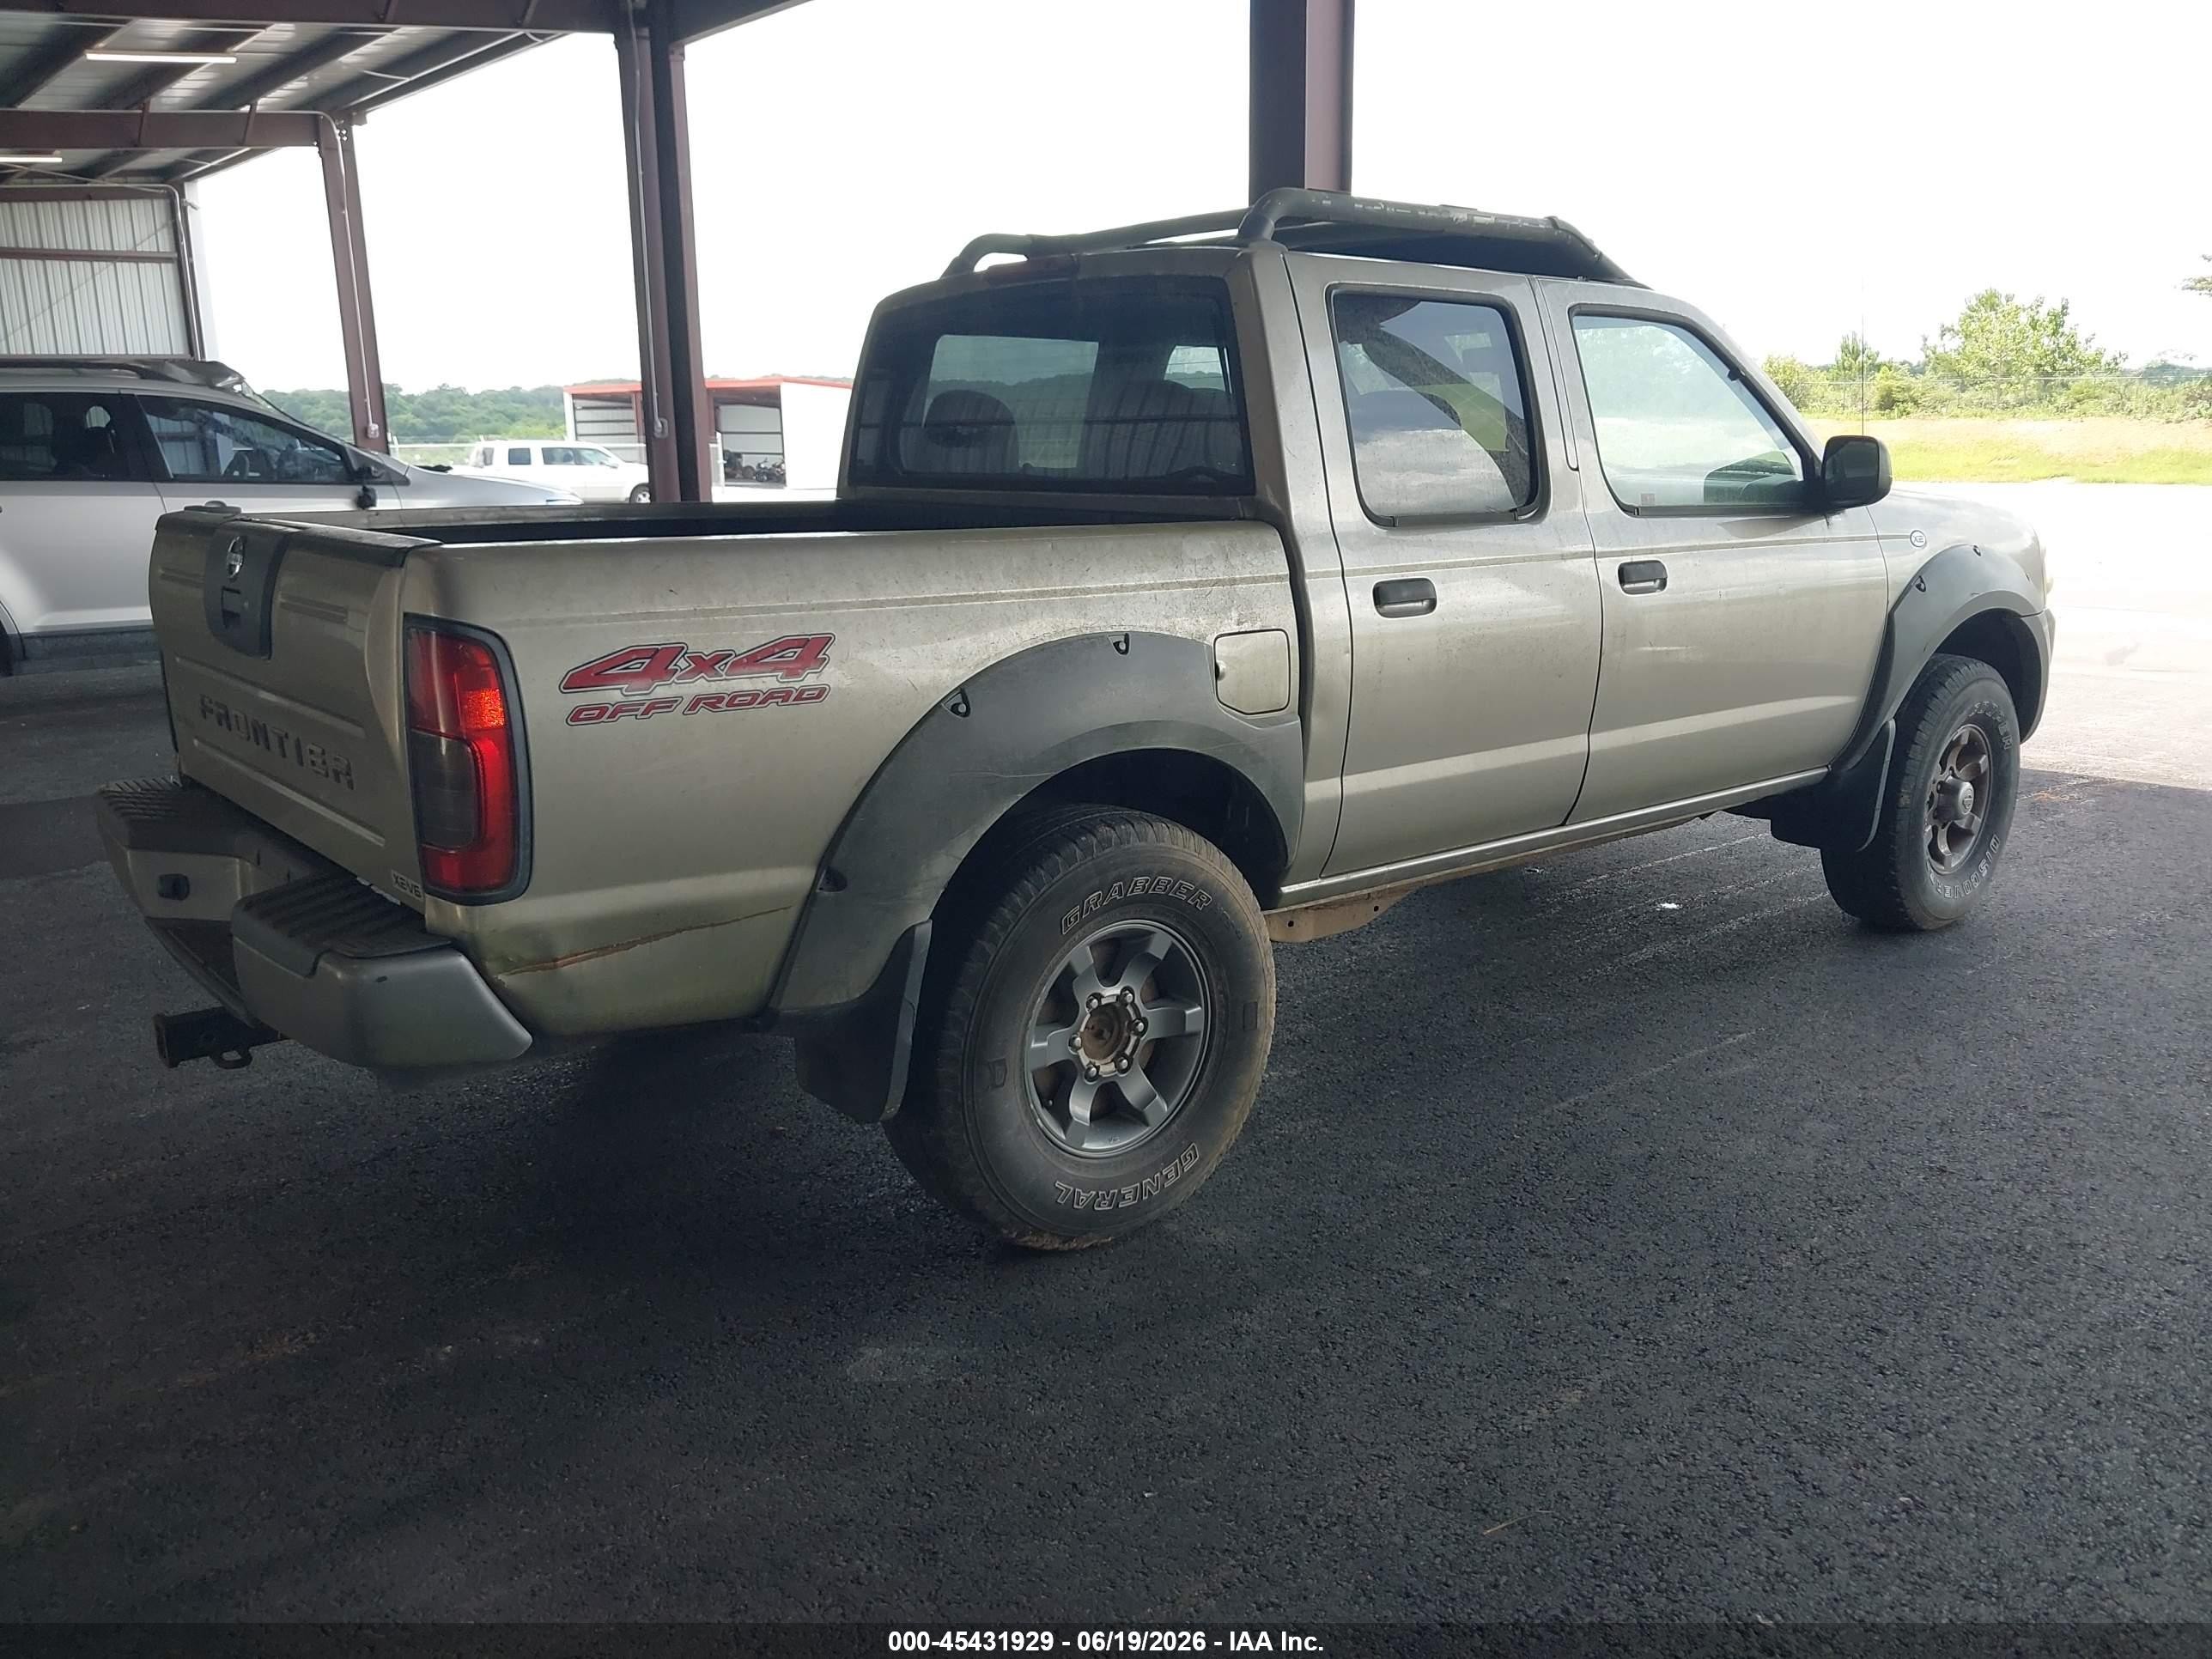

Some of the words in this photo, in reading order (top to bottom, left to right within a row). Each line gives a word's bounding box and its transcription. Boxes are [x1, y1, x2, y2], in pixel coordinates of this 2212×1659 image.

[559, 632, 836, 696] 4x4
[565, 696, 684, 726] OFF
[683, 684, 831, 715] ROAD
[200, 694, 355, 790] FRONTIER
[1061, 877, 1212, 935] GRABBER
[1054, 1143, 1200, 1211] GENERAL
